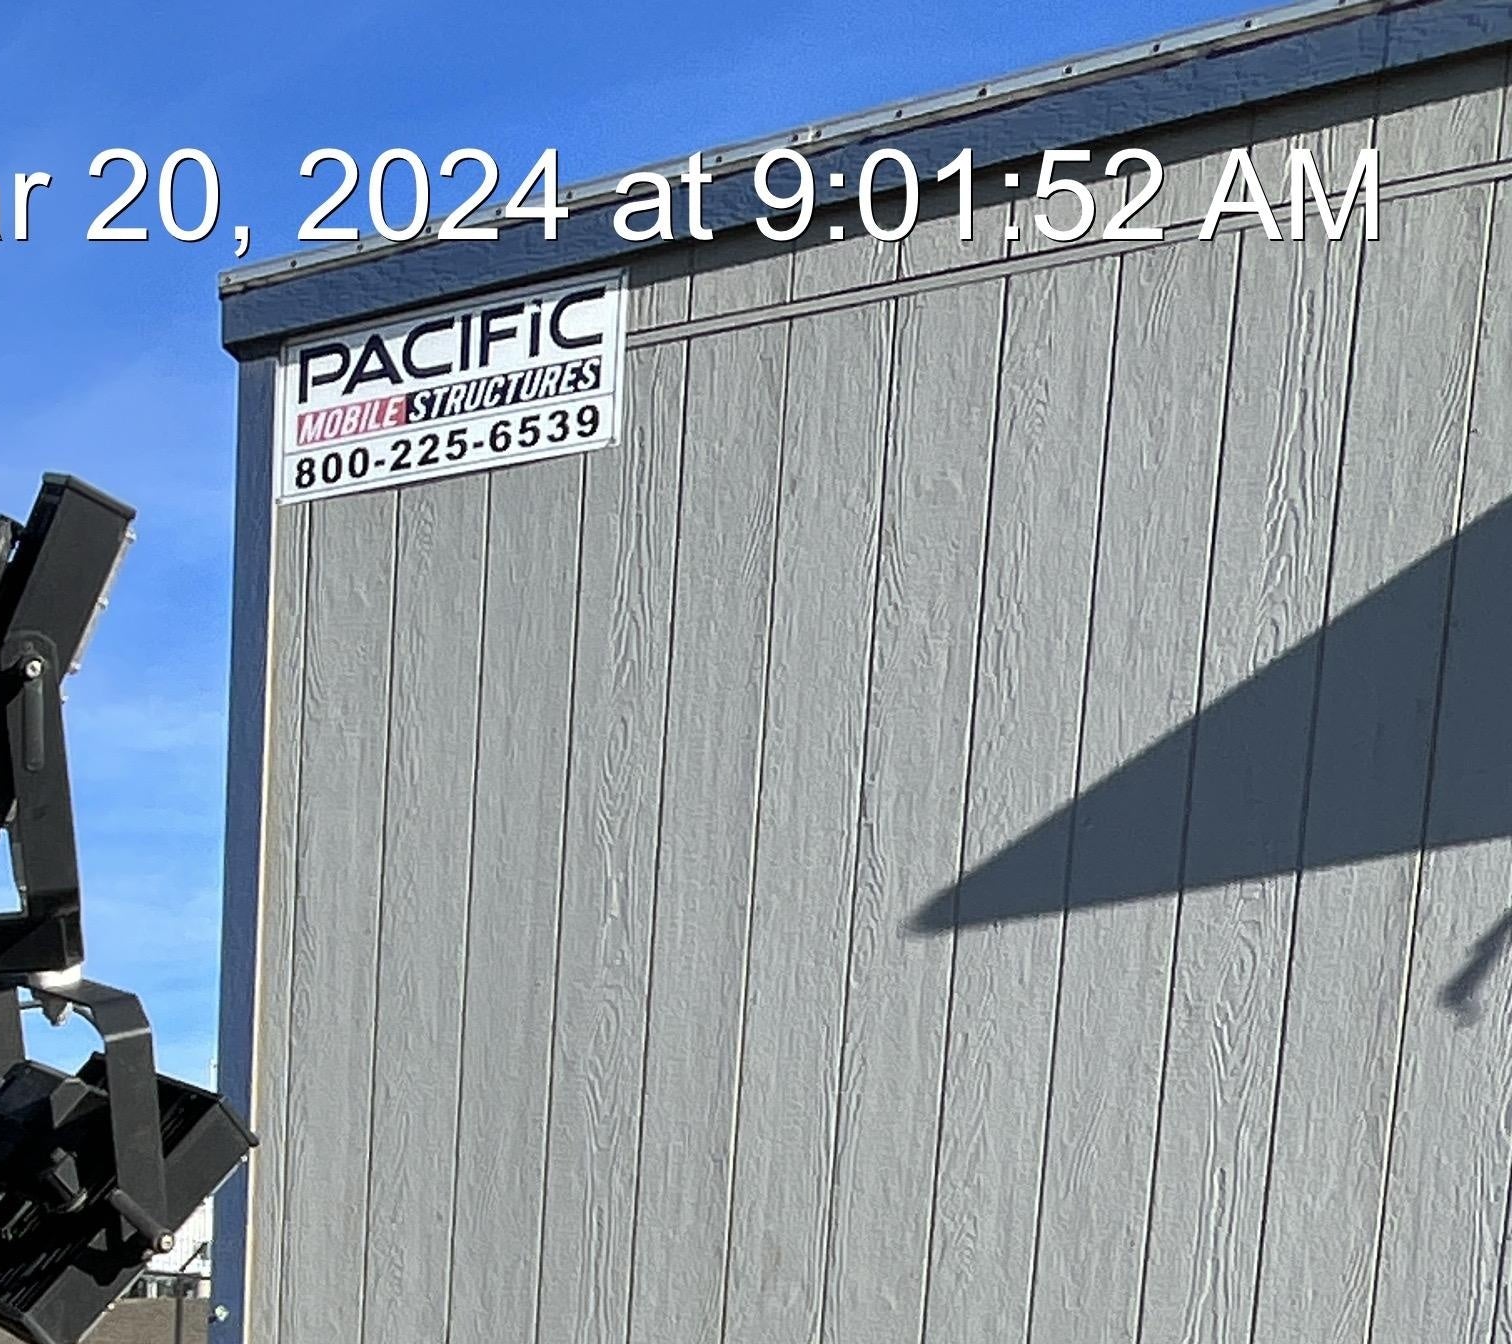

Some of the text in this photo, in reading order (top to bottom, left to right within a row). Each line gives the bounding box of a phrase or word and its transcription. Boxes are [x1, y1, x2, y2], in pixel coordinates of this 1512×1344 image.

[297, 356, 602, 446] MOBILE STRUCTURES
[294, 404, 601, 490] 800-225-6539
